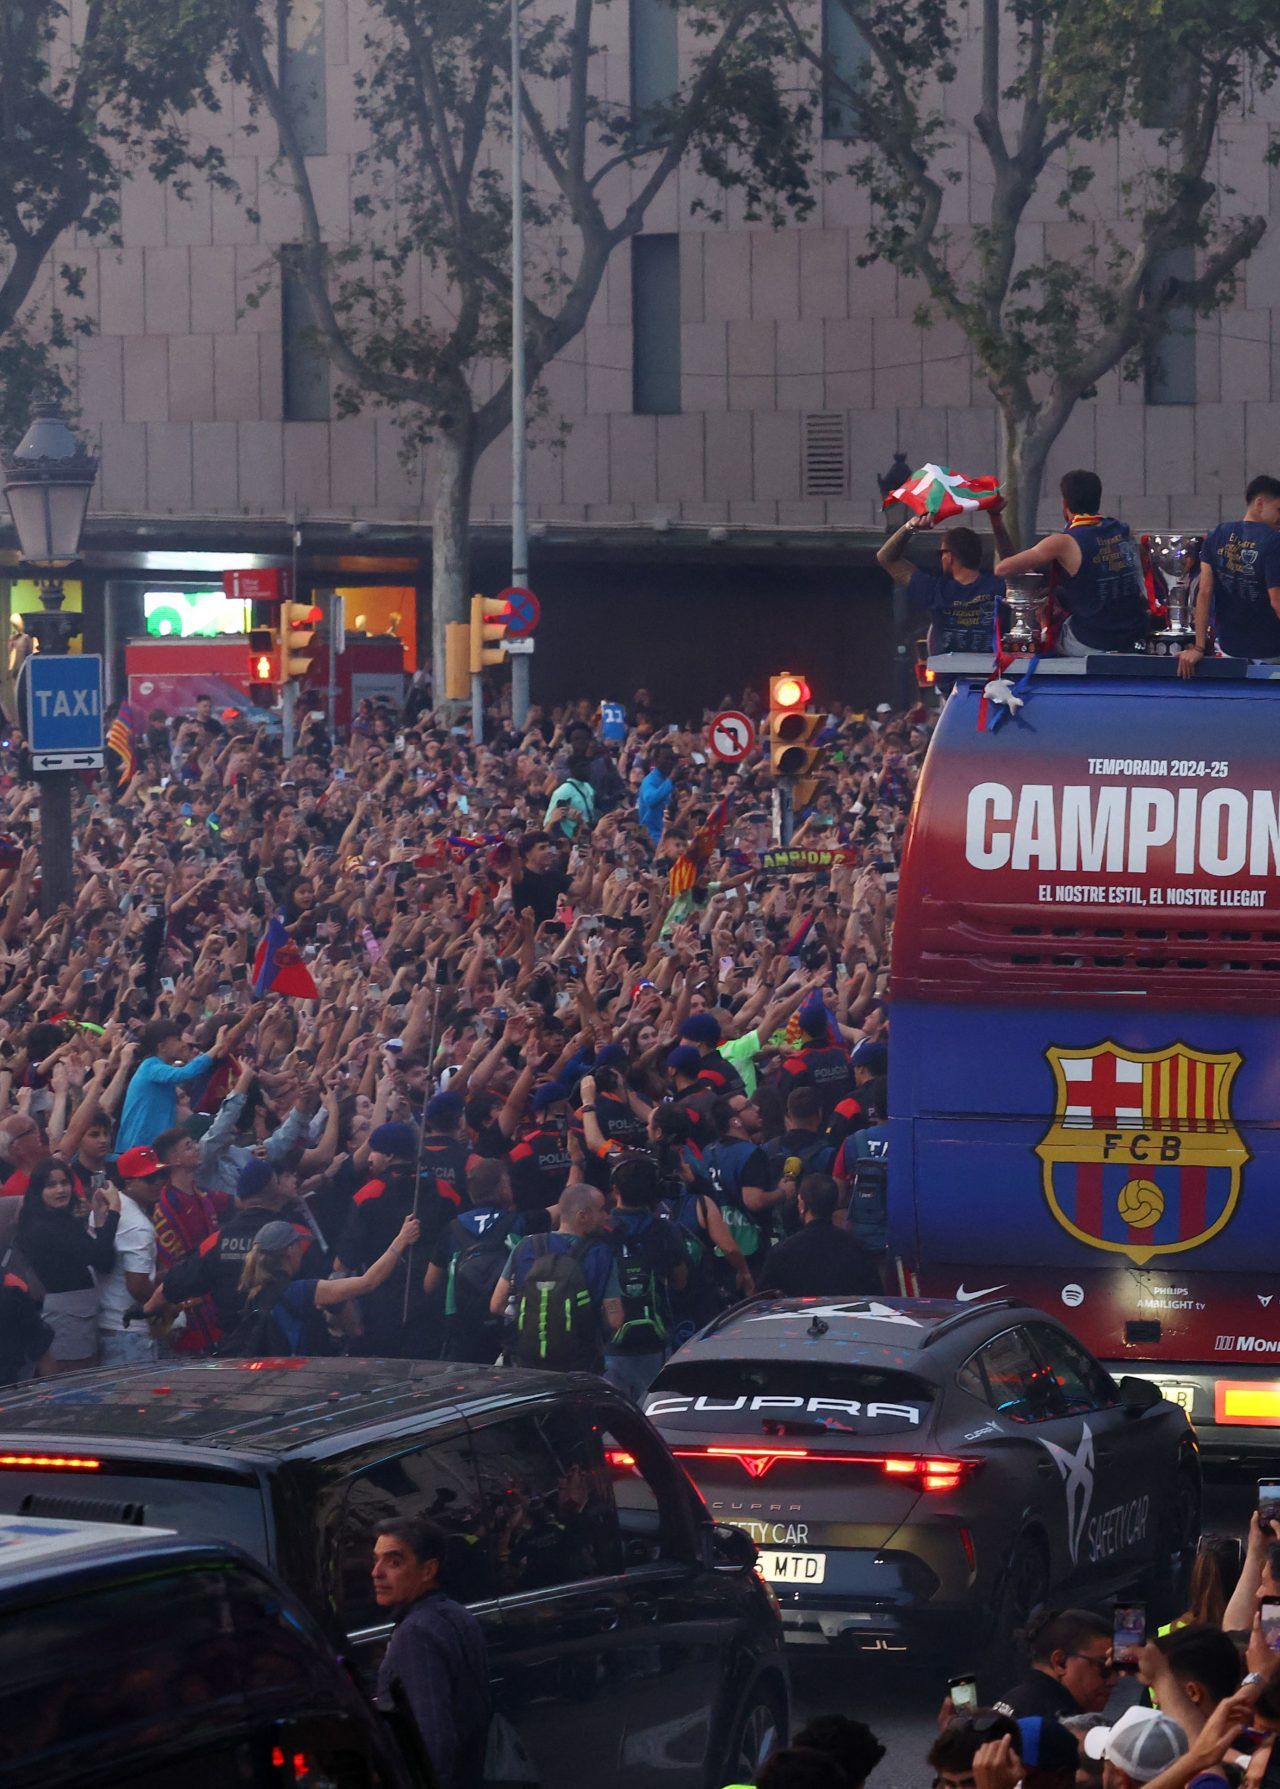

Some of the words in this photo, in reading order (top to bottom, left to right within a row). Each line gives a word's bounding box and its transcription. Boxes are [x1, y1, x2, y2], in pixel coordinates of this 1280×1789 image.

[35, 690, 97, 717] TAXI
[1088, 758, 1168, 776] TEMPORADA
[1169, 760, 1229, 777] 2024-25
[1039, 885, 1053, 902] EL
[1055, 886, 1105, 903] NOSTRE
[1109, 887, 1146, 907] ESTIL,
[1149, 889, 1164, 905] EL
[1167, 889, 1217, 906] NOSTRE
[1220, 890, 1266, 908] LLEGAT
[1103, 1134, 1182, 1161] FCB
[1153, 1287, 1189, 1295] PHILIPS
[1136, 1299, 1194, 1309] AMBILIGHT
[1196, 1302, 1206, 1310] tv
[645, 1396, 919, 1424] CUPRA
[712, 1502, 801, 1511] CUPRA
[772, 1523, 808, 1544] CAR
[1088, 1503, 1129, 1562] SAFETY
[1126, 1494, 1150, 1545] CAR
[774, 1557, 818, 1578] MTD
